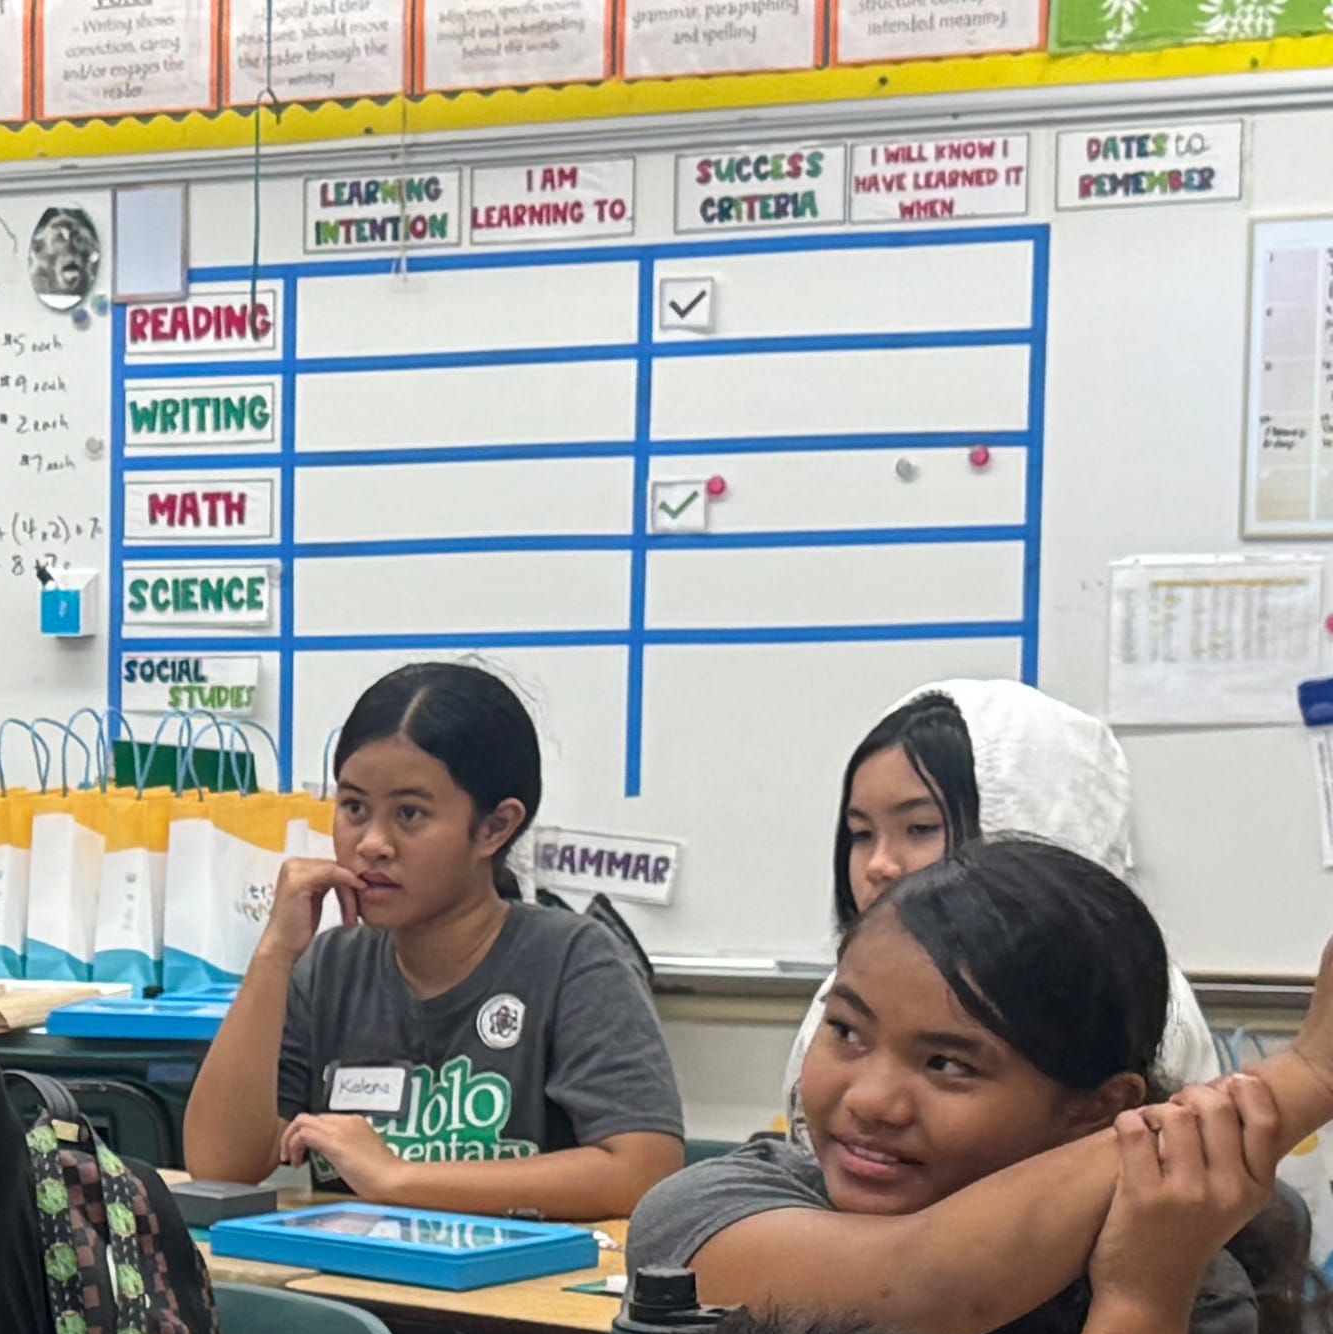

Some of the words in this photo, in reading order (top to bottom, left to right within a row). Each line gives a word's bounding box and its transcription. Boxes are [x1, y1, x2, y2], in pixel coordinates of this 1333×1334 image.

[871, 147, 877, 165] I
[885, 145, 928, 164] WILL
[935, 141, 995, 161] KNOW
[1002, 139, 1008, 157] I
[1087, 133, 1169, 162] DATES
[526, 169, 533, 192] I
[540, 167, 578, 191] AM
[696, 151, 824, 185] SUCCESS
[854, 173, 907, 194] HAVE
[913, 168, 998, 190] LEARNED
[1005, 166, 1023, 186] IT
[1079, 167, 1215, 199] REMEMBER
[321, 176, 442, 208] LEARNING
[700, 190, 818, 223] CRITERIA
[315, 213, 448, 245] INTENTION
[471, 202, 585, 229] LEARNING
[130, 303, 272, 343] READING
[128, 394, 270, 434] WRITING
[148, 491, 247, 527] MATH
[128, 576, 265, 614] SCIENCE
[124, 659, 207, 683] SOCIAL
[168, 684, 255, 709] STUDIES
[539, 846, 671, 885] RAMMAR
